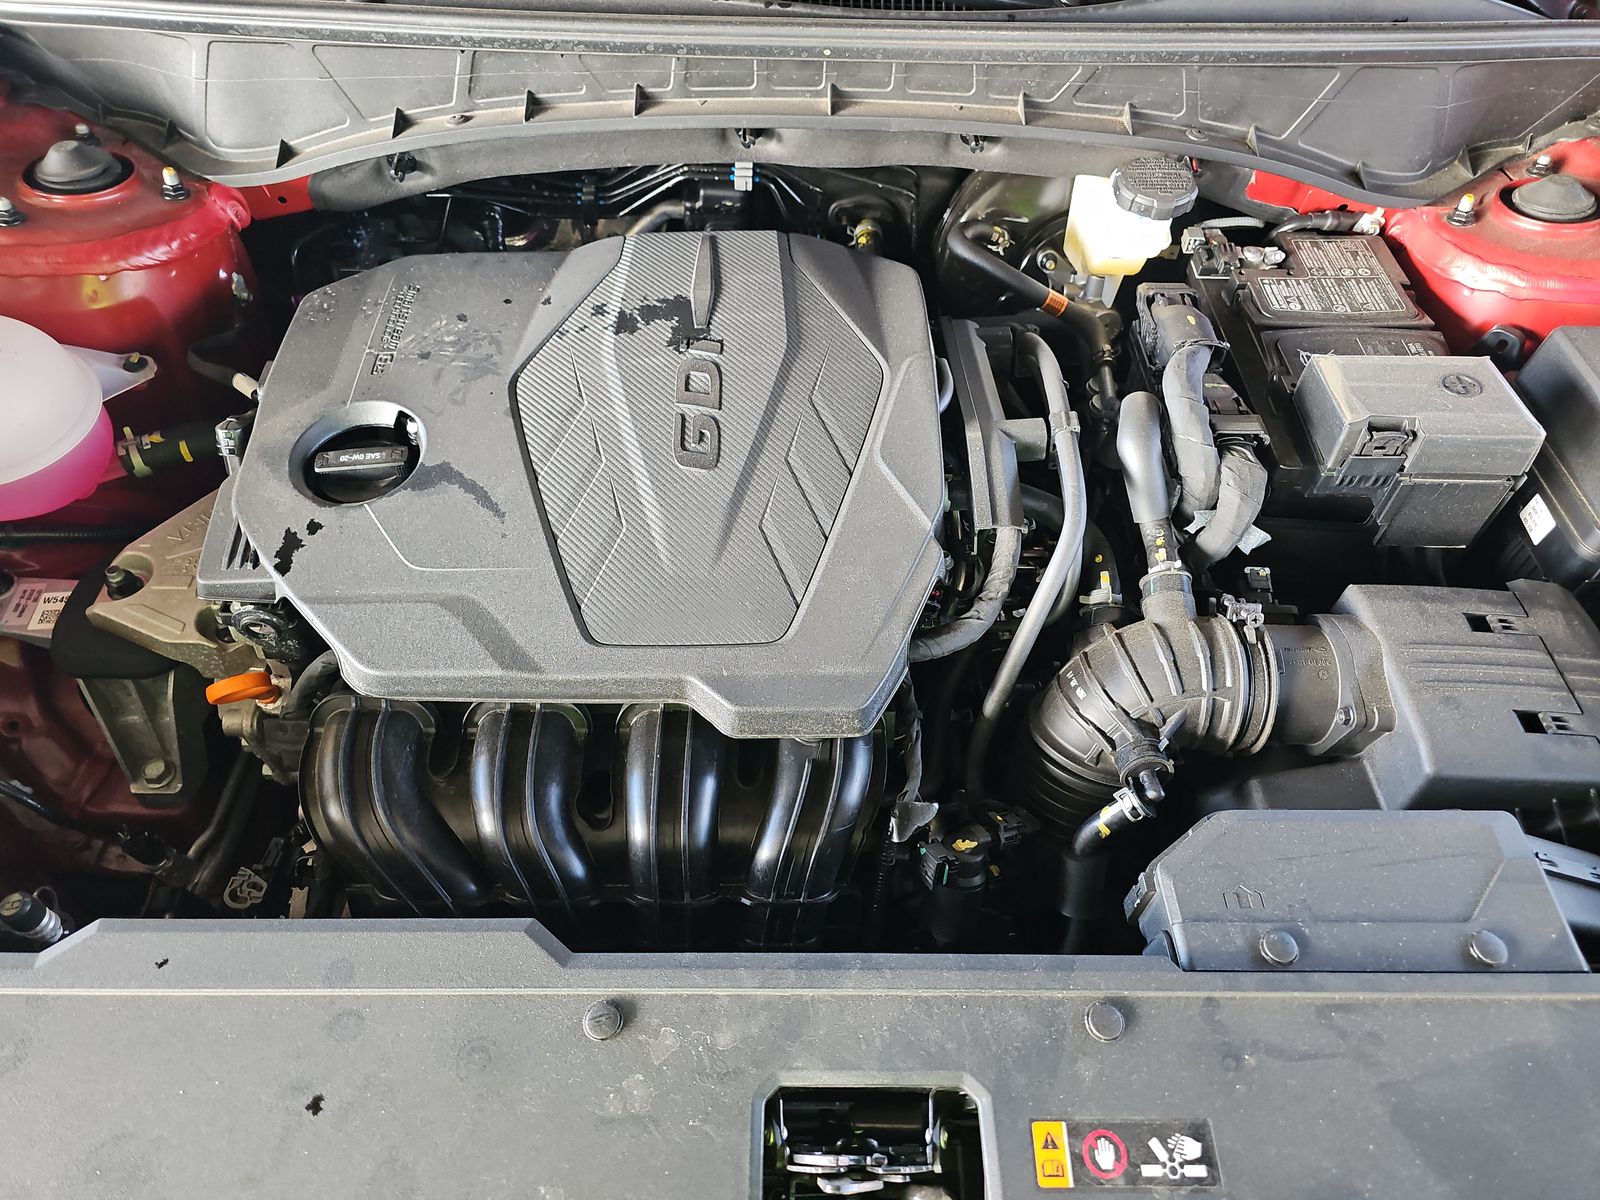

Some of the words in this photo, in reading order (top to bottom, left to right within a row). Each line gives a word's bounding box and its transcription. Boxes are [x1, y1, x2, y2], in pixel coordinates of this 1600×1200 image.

[388, 284, 420, 350] Smartstream
[340, 453, 365, 462] 0W-20
[366, 452, 381, 460] SAE
